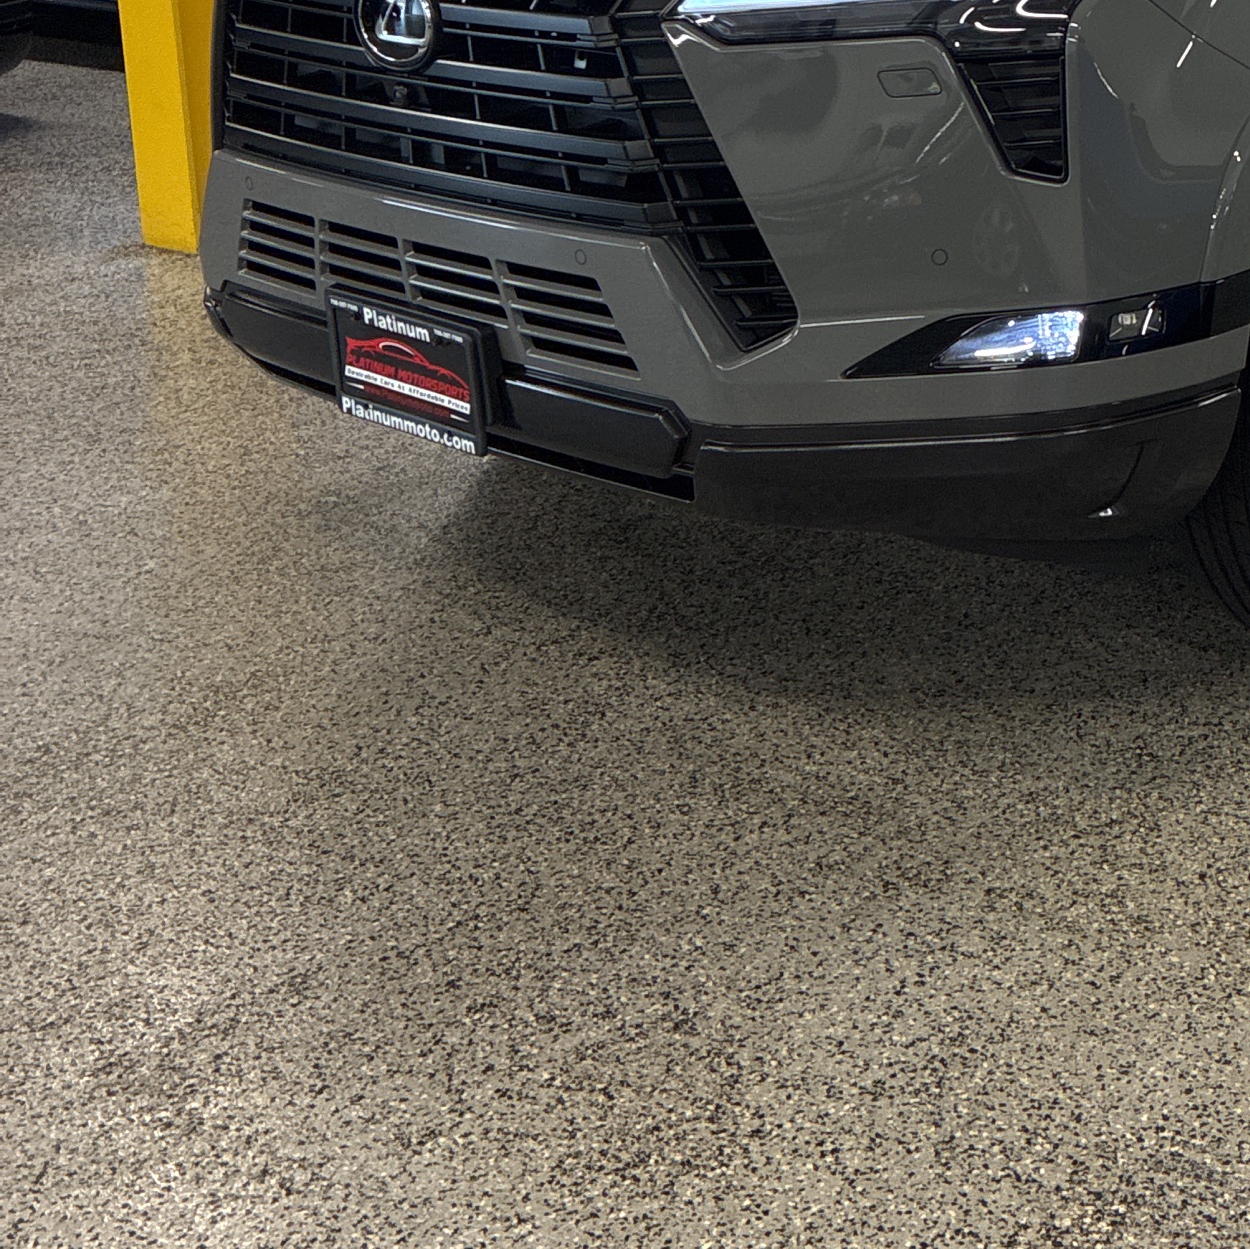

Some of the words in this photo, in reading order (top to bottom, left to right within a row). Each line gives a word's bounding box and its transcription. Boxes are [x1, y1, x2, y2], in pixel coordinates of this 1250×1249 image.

[362, 306, 431, 343] Platinum
[345, 353, 396, 377] PLATINUM
[397, 368, 470, 401] MOTORSPORTS
[347, 368, 378, 382] Desirable
[380, 377, 395, 388] Cars
[397, 383, 405, 392] At
[408, 387, 445, 404] Affordable
[447, 399, 469, 412] Prices
[341, 396, 476, 455] Platinummoto.com
